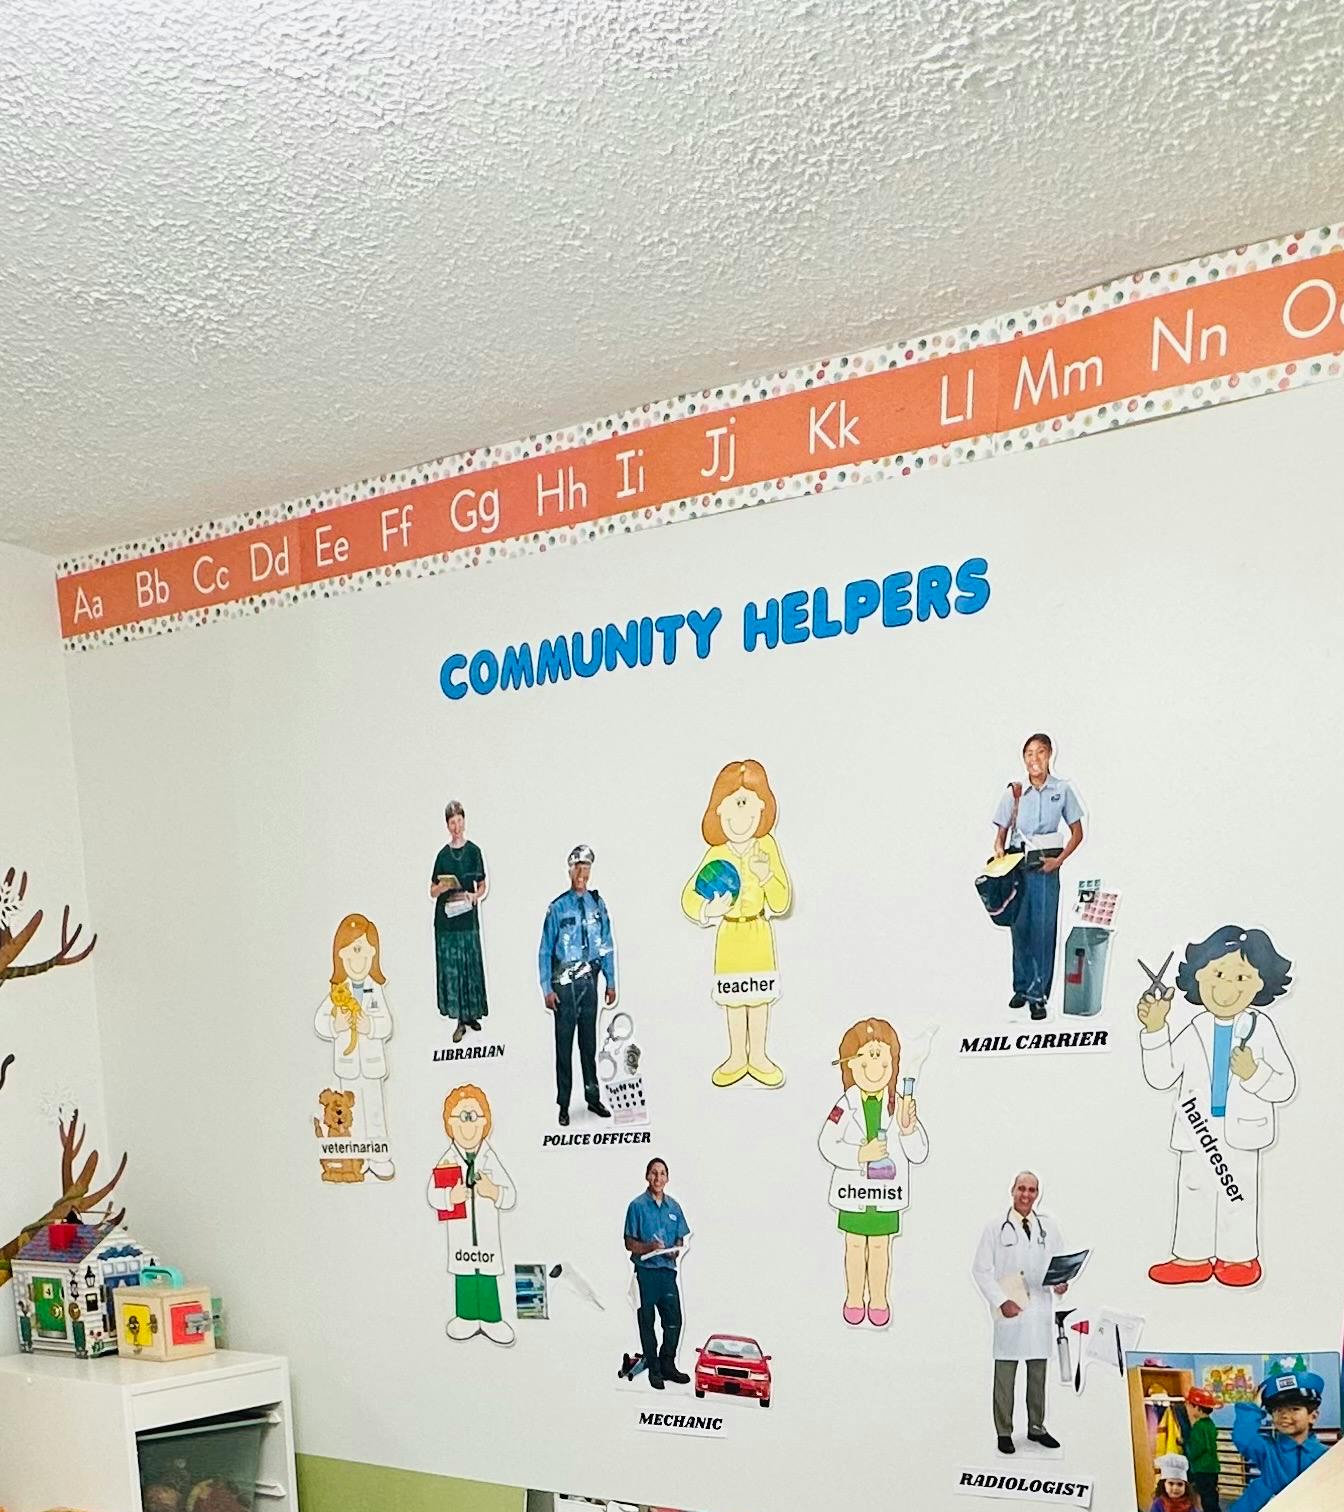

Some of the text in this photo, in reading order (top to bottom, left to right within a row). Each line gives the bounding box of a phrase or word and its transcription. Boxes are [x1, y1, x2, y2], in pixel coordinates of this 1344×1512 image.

[74, 586, 104, 621] Aa
[137, 568, 170, 607] Bb
[193, 556, 229, 594] Cc
[251, 536, 289, 581] Dd
[316, 525, 348, 567] Ee
[382, 505, 413, 551] Ff
[451, 489, 499, 533] Gg
[538, 472, 587, 516] Hh
[616, 449, 643, 498] Ii
[701, 417, 736, 482] Jj
[810, 400, 860, 454] Kk
[941, 369, 973, 425] Ll
[1014, 349, 1104, 411] Mm
[1152, 309, 1227, 371] Nn
[440, 558, 990, 700] COMMUNITY HELPERS
[717, 975, 775, 996] teacher
[959, 1031, 1108, 1053] MAIL CARRIER
[432, 1044, 506, 1063] LIBRARIAN
[321, 1140, 389, 1157] veterinarian
[542, 1131, 651, 1147] POLICE OFFICER
[1182, 1096, 1244, 1204] hairdresser
[837, 1183, 904, 1202] chemist
[455, 1249, 495, 1264] doctor
[638, 1411, 723, 1431] MECHANIC
[958, 1472, 1089, 1499] RADIOLOGIST
